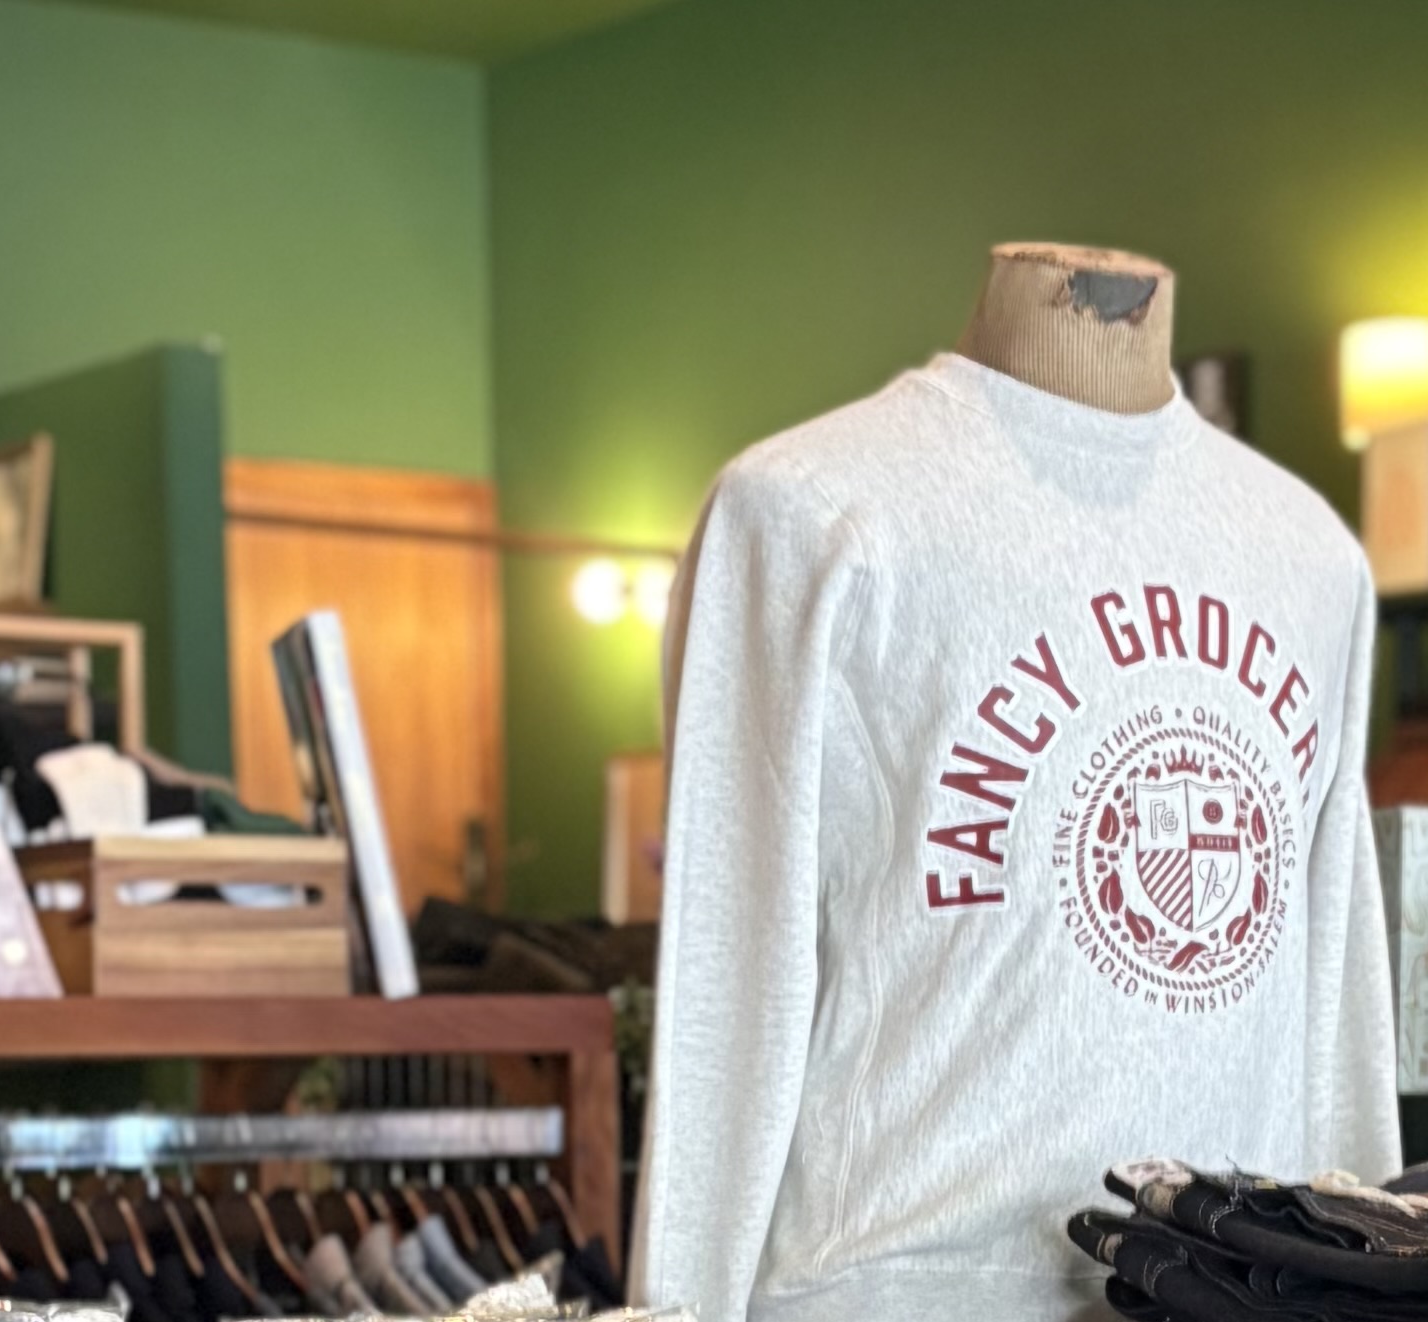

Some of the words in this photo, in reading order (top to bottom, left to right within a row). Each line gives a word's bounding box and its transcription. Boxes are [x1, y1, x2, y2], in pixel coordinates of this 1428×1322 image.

[926, 632, 1081, 908] FANCY
[1091, 582, 1318, 808] GROCER
[1052, 807, 1079, 868] FINE
[1072, 704, 1164, 799] CLOTHING
[1192, 705, 1272, 773] QUALITY
[1269, 779, 1297, 870] BASICS
[1059, 895, 1140, 998] FOUNDED
